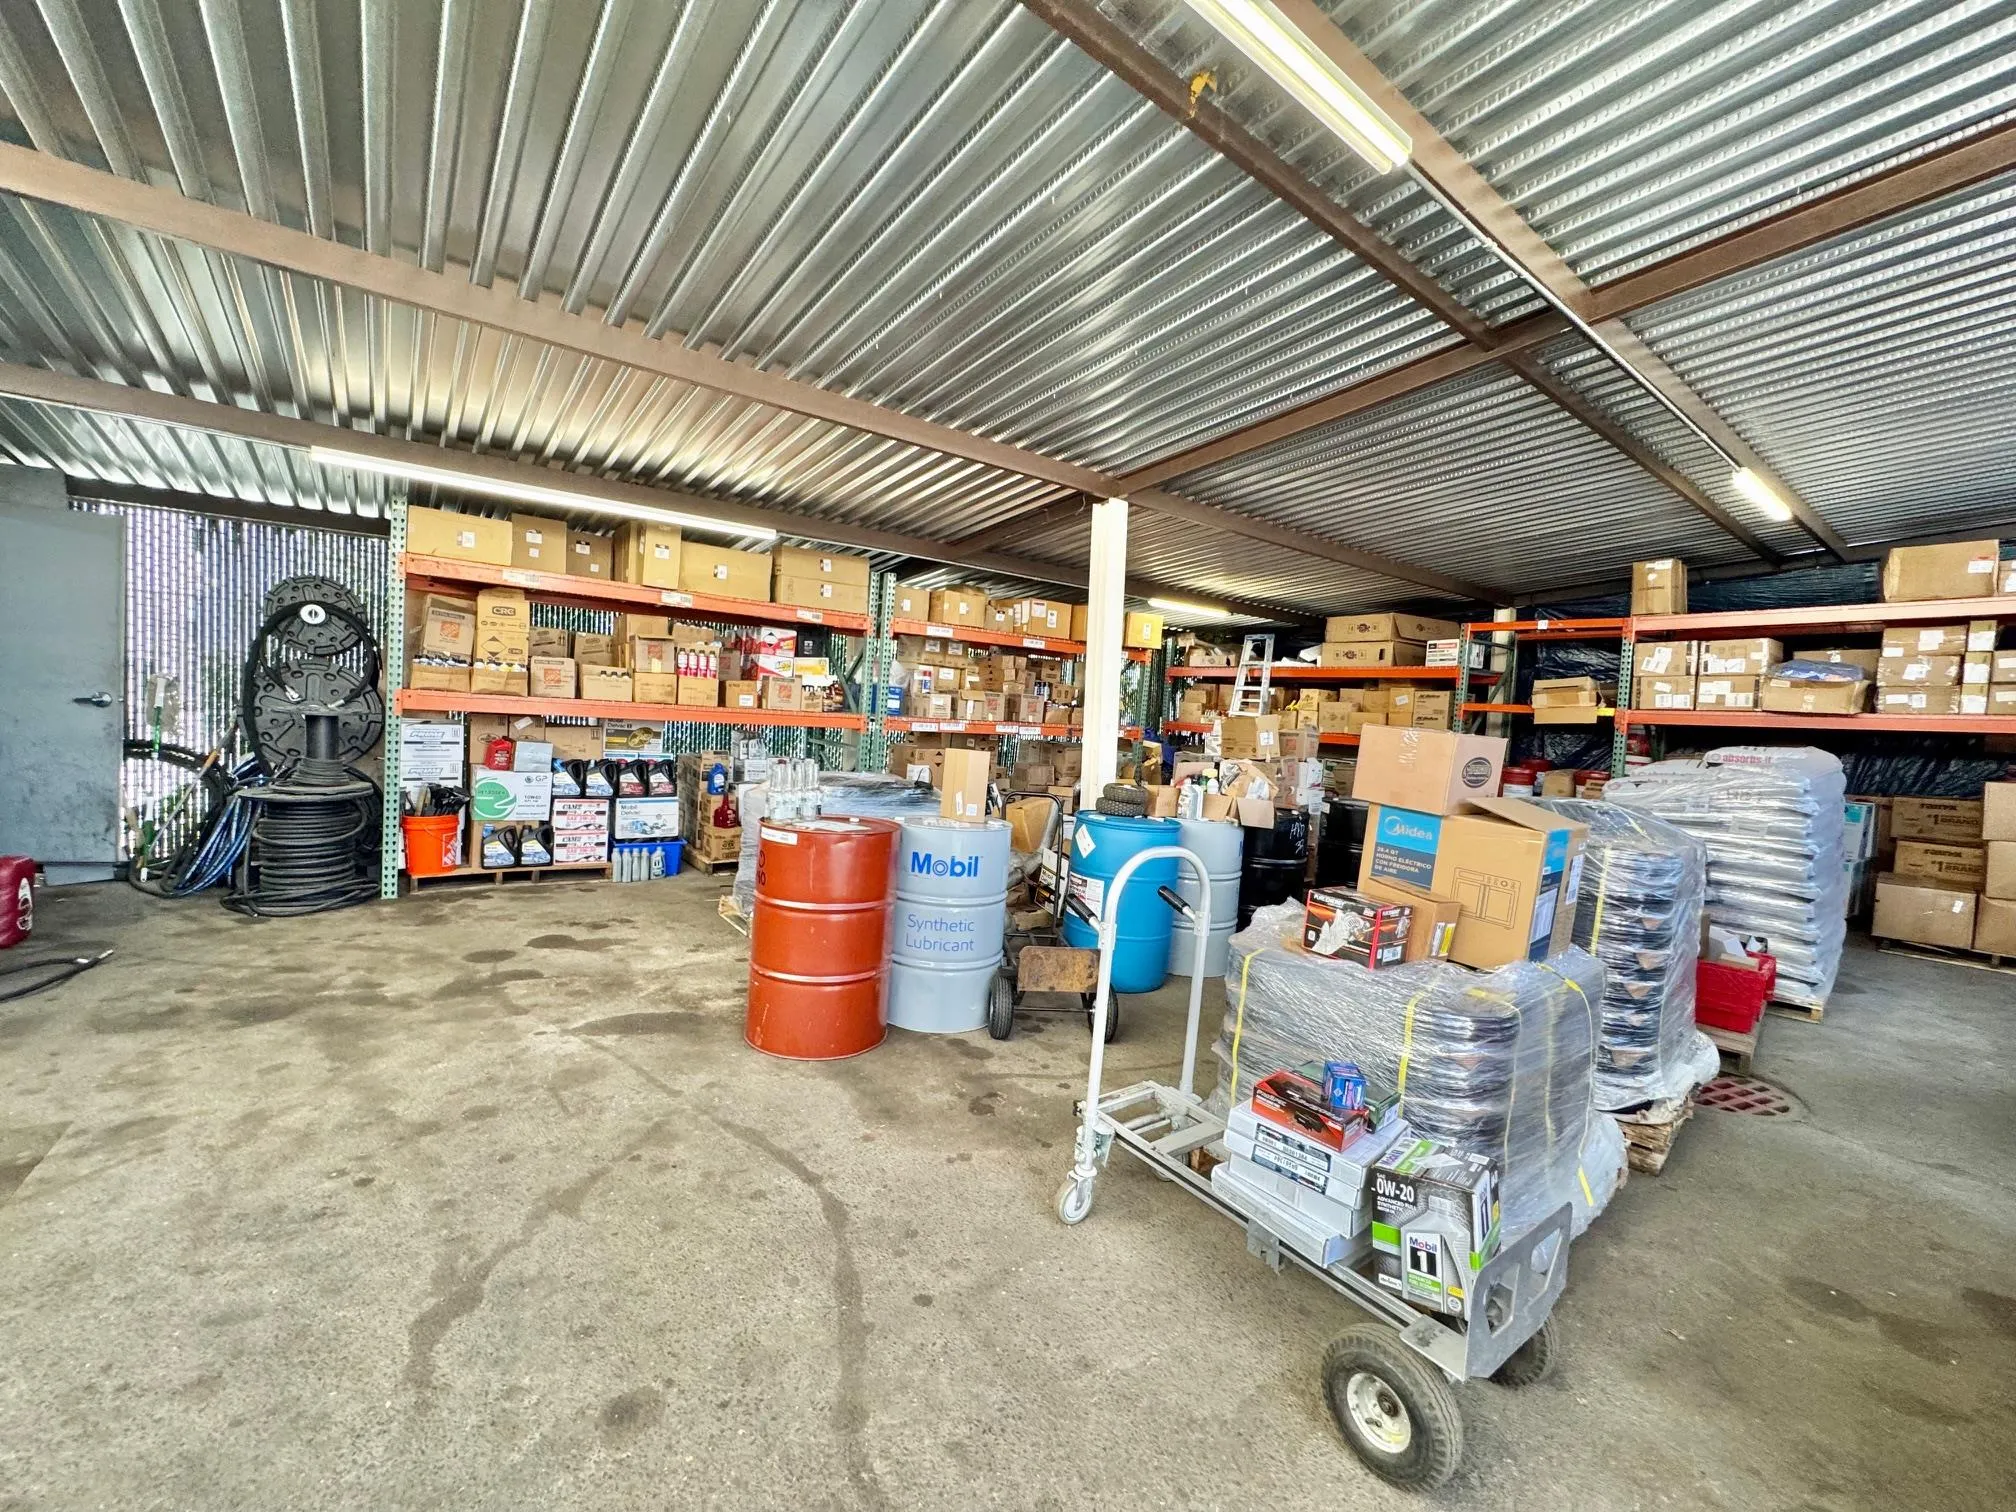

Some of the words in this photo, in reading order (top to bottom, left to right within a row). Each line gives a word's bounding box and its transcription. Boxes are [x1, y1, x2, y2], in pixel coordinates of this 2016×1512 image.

[1384, 815, 1433, 840] Midea
[911, 851, 979, 877] Mobil
[907, 913, 975, 932] Synthetic
[905, 932, 974, 952] Lubricant
[1409, 1236, 1438, 1253] Mobil
[1416, 1250, 1428, 1273] 1
